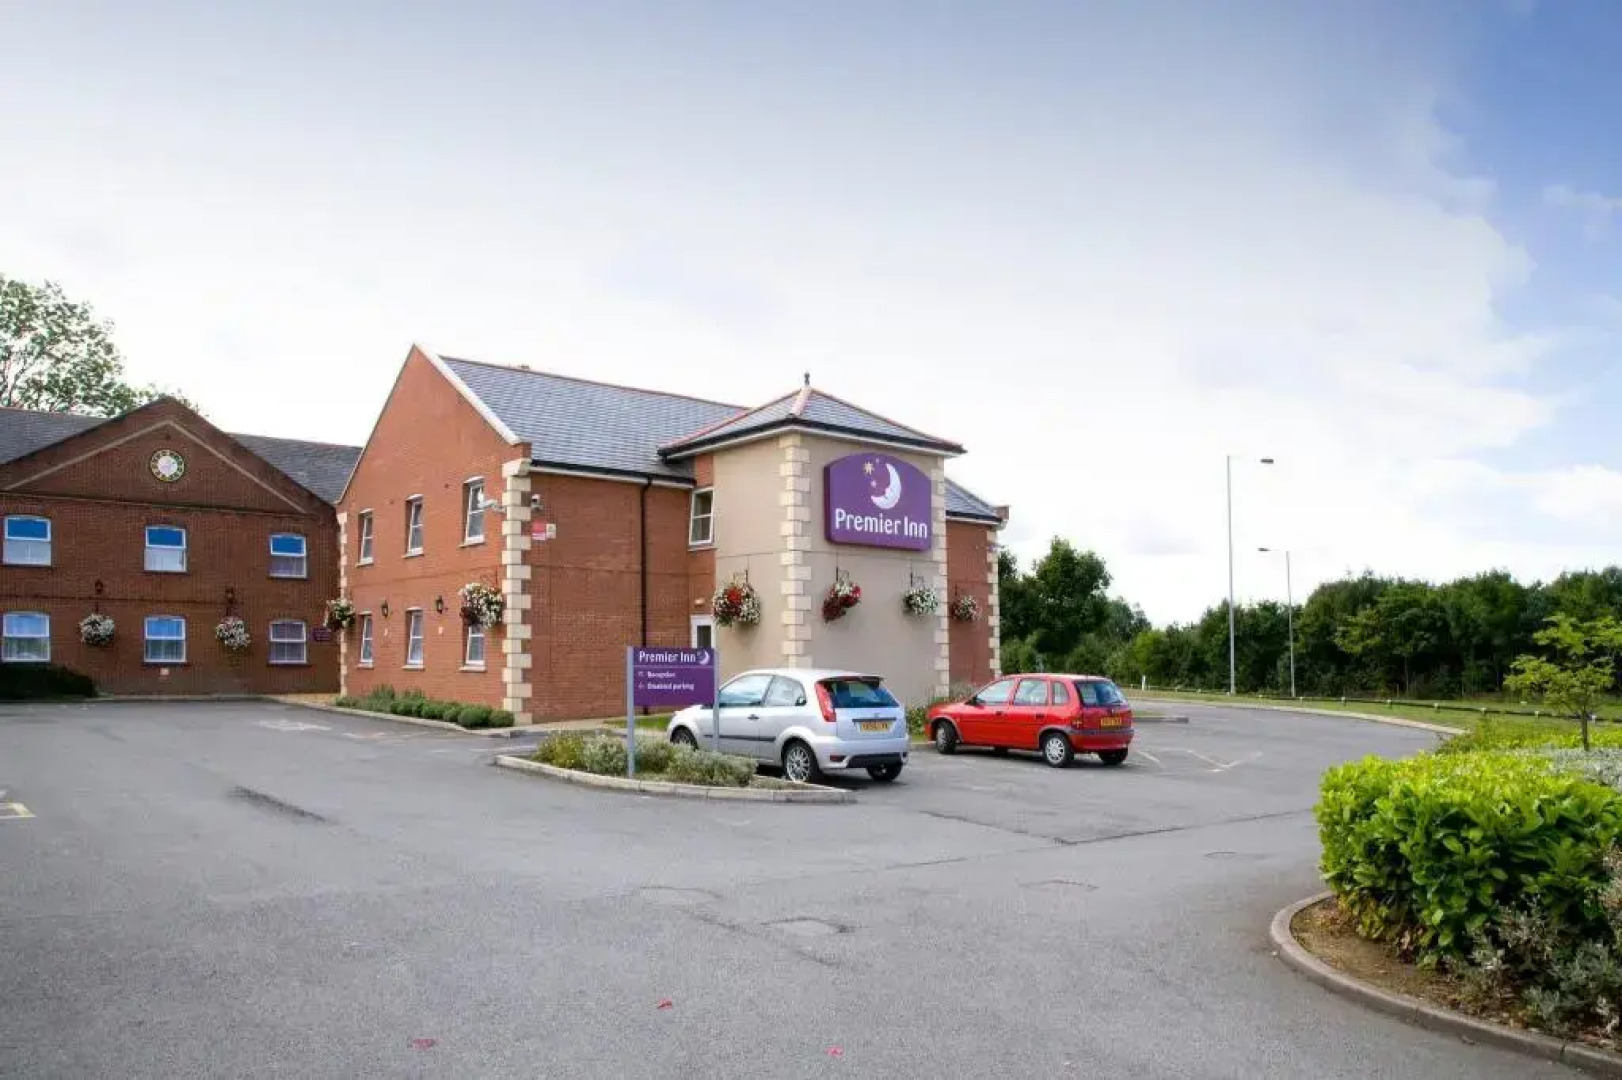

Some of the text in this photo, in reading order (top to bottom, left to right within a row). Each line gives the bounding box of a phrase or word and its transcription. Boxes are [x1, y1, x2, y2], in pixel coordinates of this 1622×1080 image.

[835, 508, 927, 538] Premier Inn
[639, 650, 696, 662] Premier Inn
